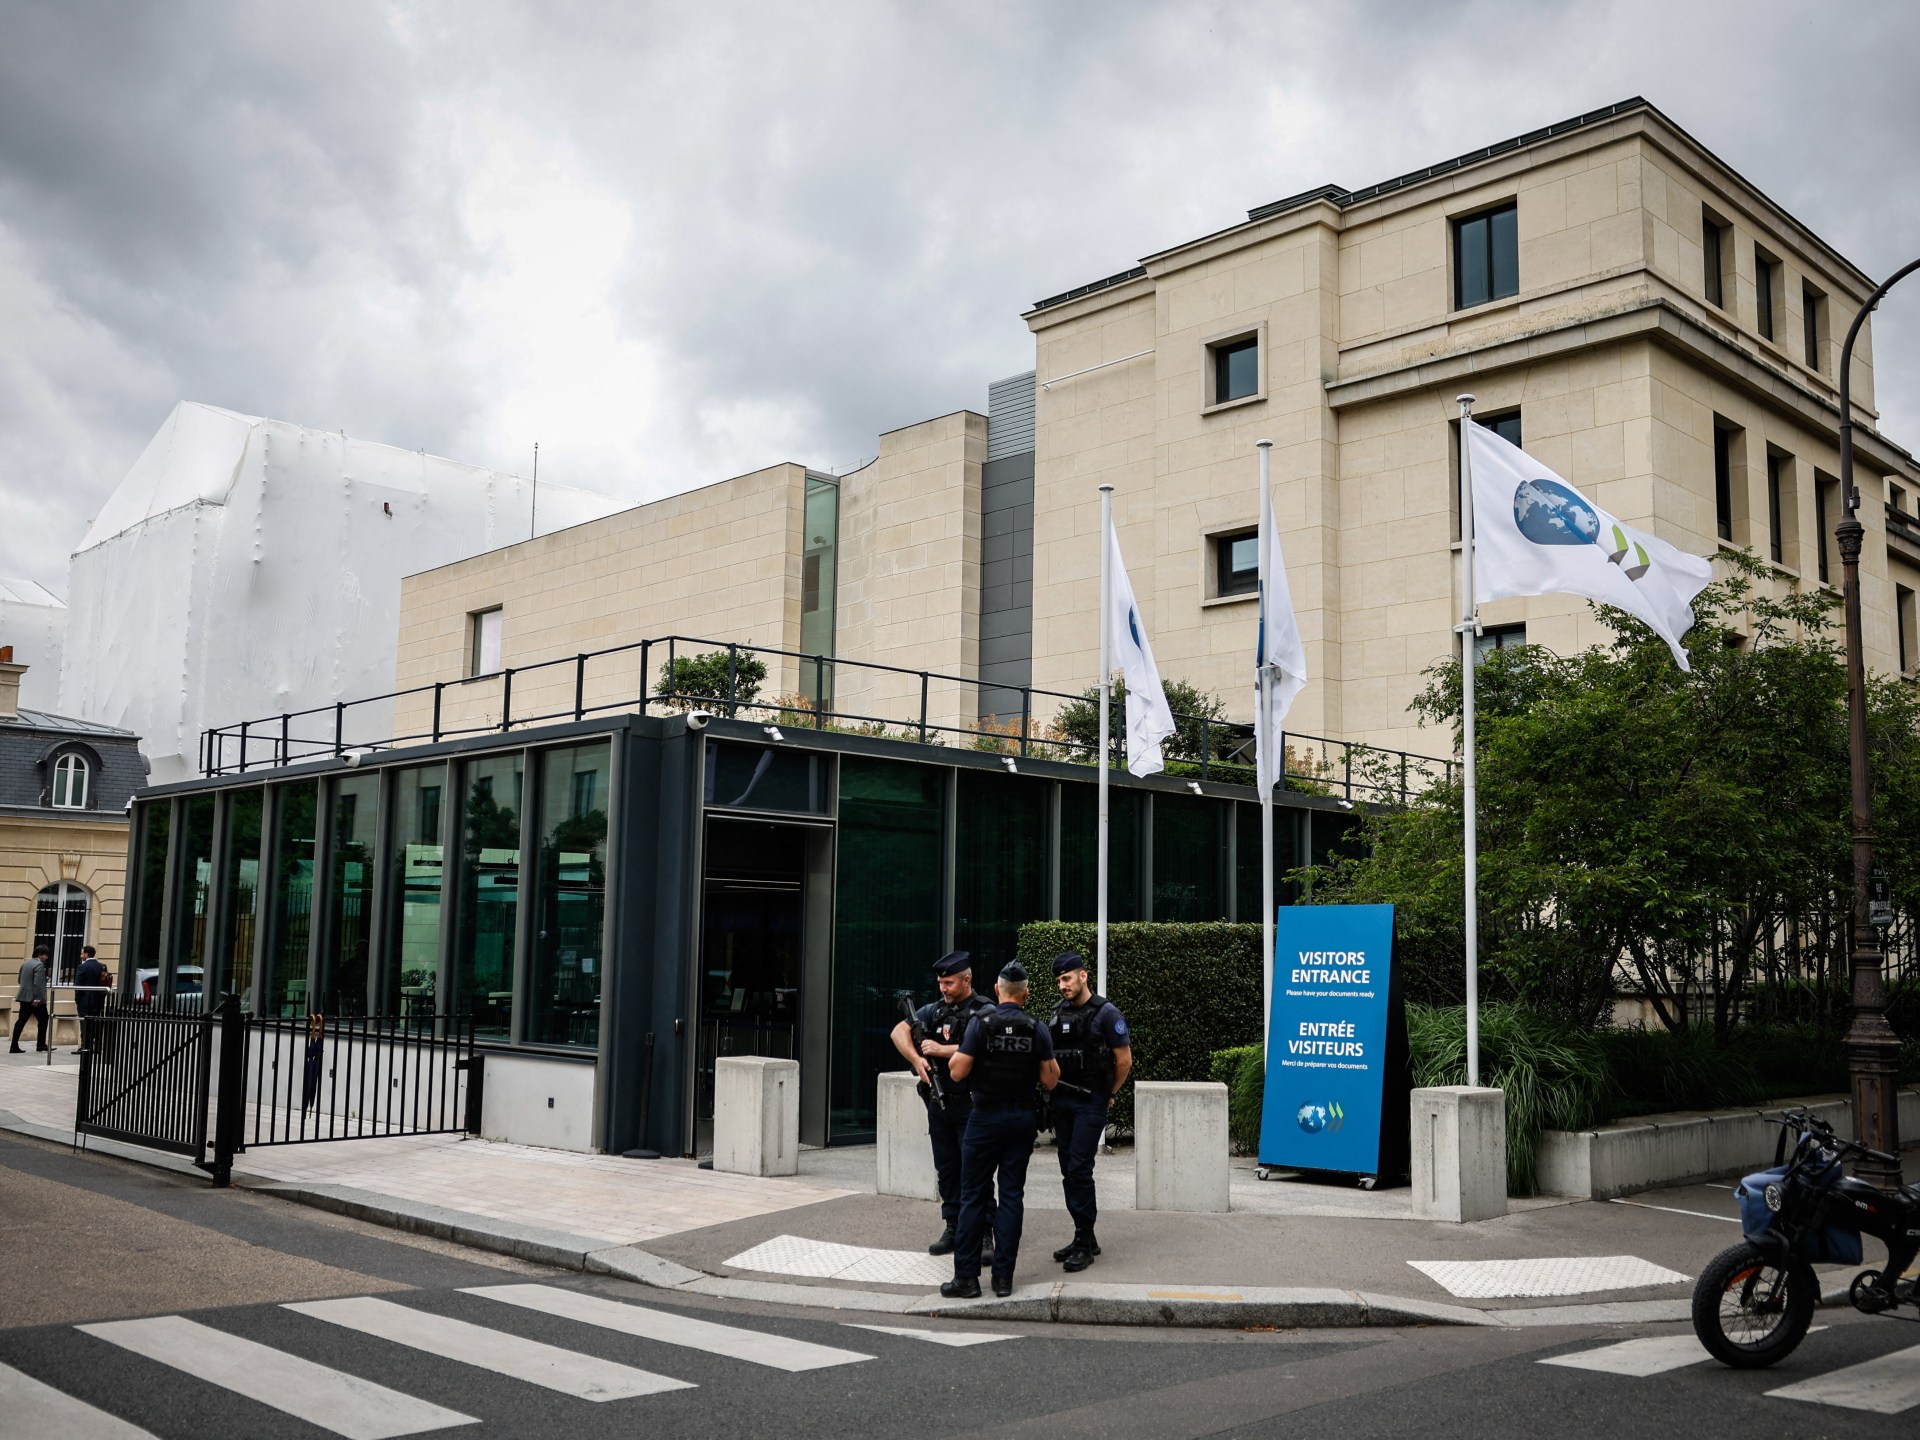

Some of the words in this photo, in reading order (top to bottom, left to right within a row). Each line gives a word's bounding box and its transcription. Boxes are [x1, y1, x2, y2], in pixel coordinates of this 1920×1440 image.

[1299, 952, 1365, 966] VISITORS
[1292, 970, 1370, 984] ENTRANCE
[1300, 1020, 1355, 1038] ENTRÉE
[992, 1038, 1030, 1050] CRS
[1288, 1040, 1364, 1056] VISITEURS
